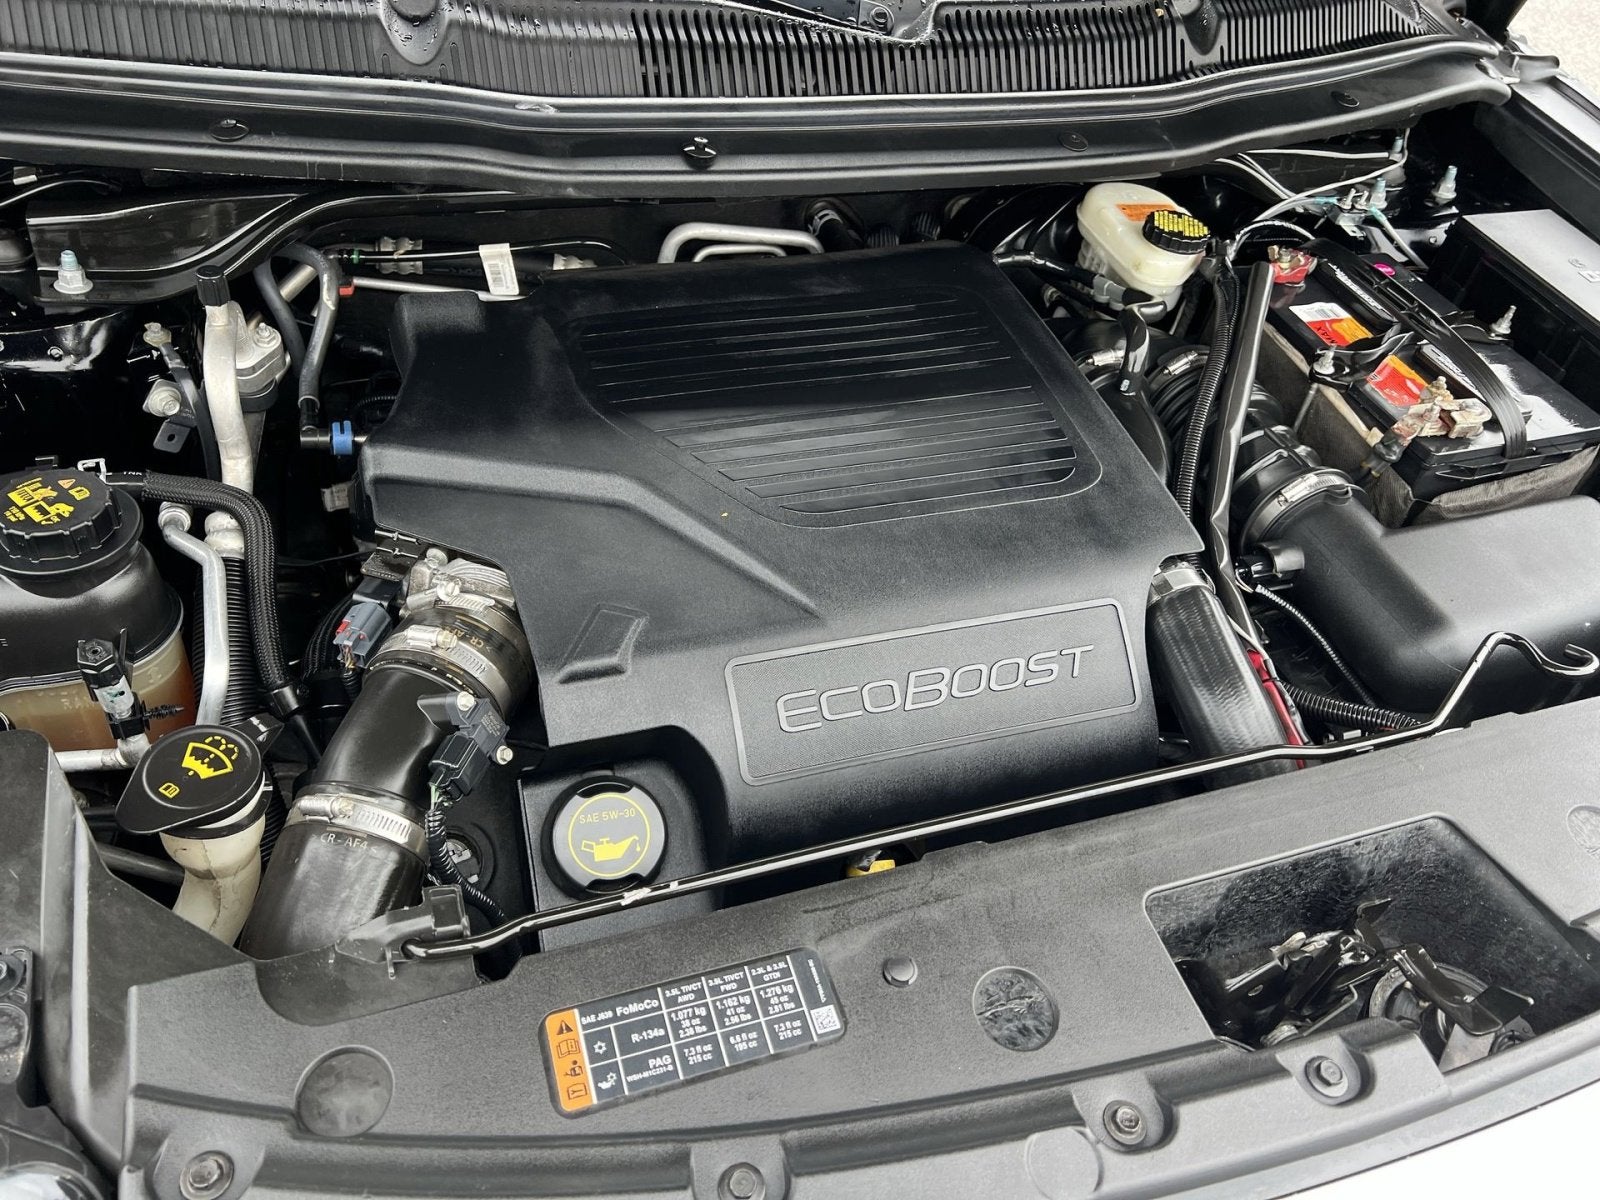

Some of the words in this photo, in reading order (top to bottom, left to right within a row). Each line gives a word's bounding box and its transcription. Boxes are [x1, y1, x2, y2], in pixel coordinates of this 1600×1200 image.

[579, 812, 599, 824] SAE
[601, 808, 636, 821] 5W-30
[720, 982, 738, 993] FWD
[783, 984, 795, 994] kg
[677, 993, 696, 1004] AWD
[739, 995, 751, 1005] kg
[780, 994, 790, 1002] oz
[726, 1008, 735, 1016] 41
[736, 1006, 746, 1014] oz
[783, 1001, 796, 1010] lbs
[581, 1014, 597, 1025] SAE
[616, 999, 659, 1017] FoMoCo
[671, 1008, 693, 1022] 1.077
[694, 1007, 707, 1017] kg
[740, 1013, 752, 1022] lbs
[680, 1020, 690, 1028] 38
[691, 1018, 701, 1026] oz
[774, 1023, 786, 1032] 7.3
[631, 1028, 665, 1044] R-134a
[678, 1028, 694, 1038] 2.38
[695, 1025, 707, 1034] lbs
[748, 1031, 758, 1039] oz
[778, 1031, 793, 1040] 215
[792, 1028, 802, 1036] cc
[734, 1043, 748, 1052] 195
[748, 1040, 758, 1048] cc
[683, 1047, 695, 1057] 7.3
[648, 1055, 672, 1069] PAG
[687, 1055, 703, 1065] 215
[703, 1053, 713, 1061] cc
